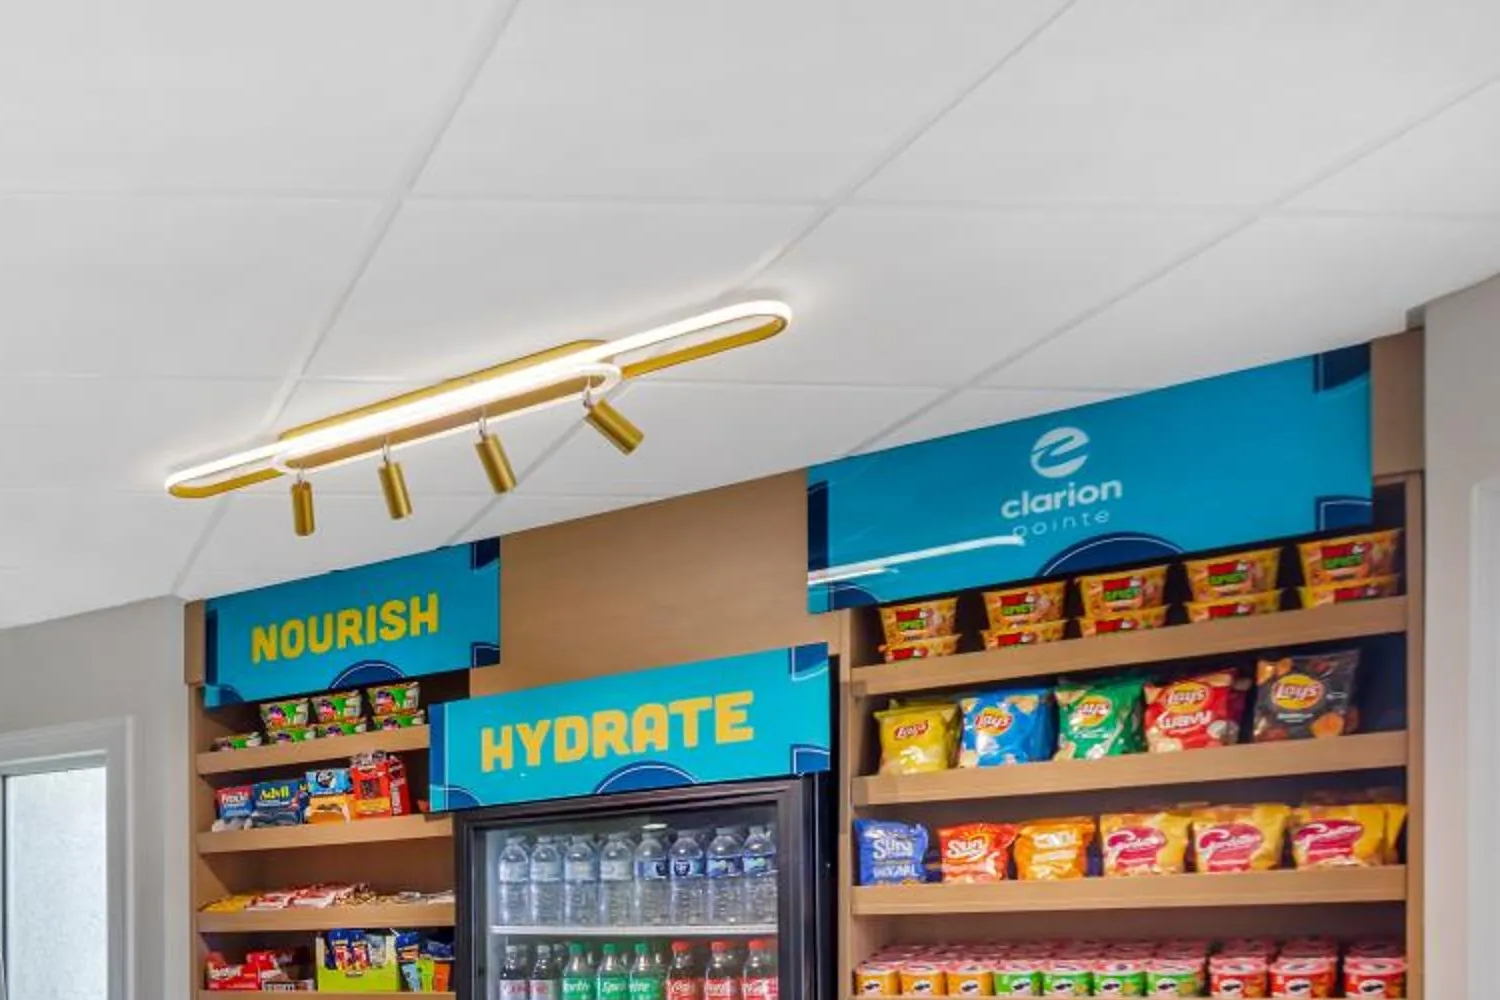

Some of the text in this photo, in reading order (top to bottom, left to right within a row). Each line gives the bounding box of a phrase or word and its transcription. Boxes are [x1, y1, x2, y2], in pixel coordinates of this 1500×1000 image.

[1000, 480, 1123, 519] clarion
[1011, 509, 1110, 538] pointe
[250, 593, 439, 664] NOURISH
[480, 690, 755, 773] HYDRATE
